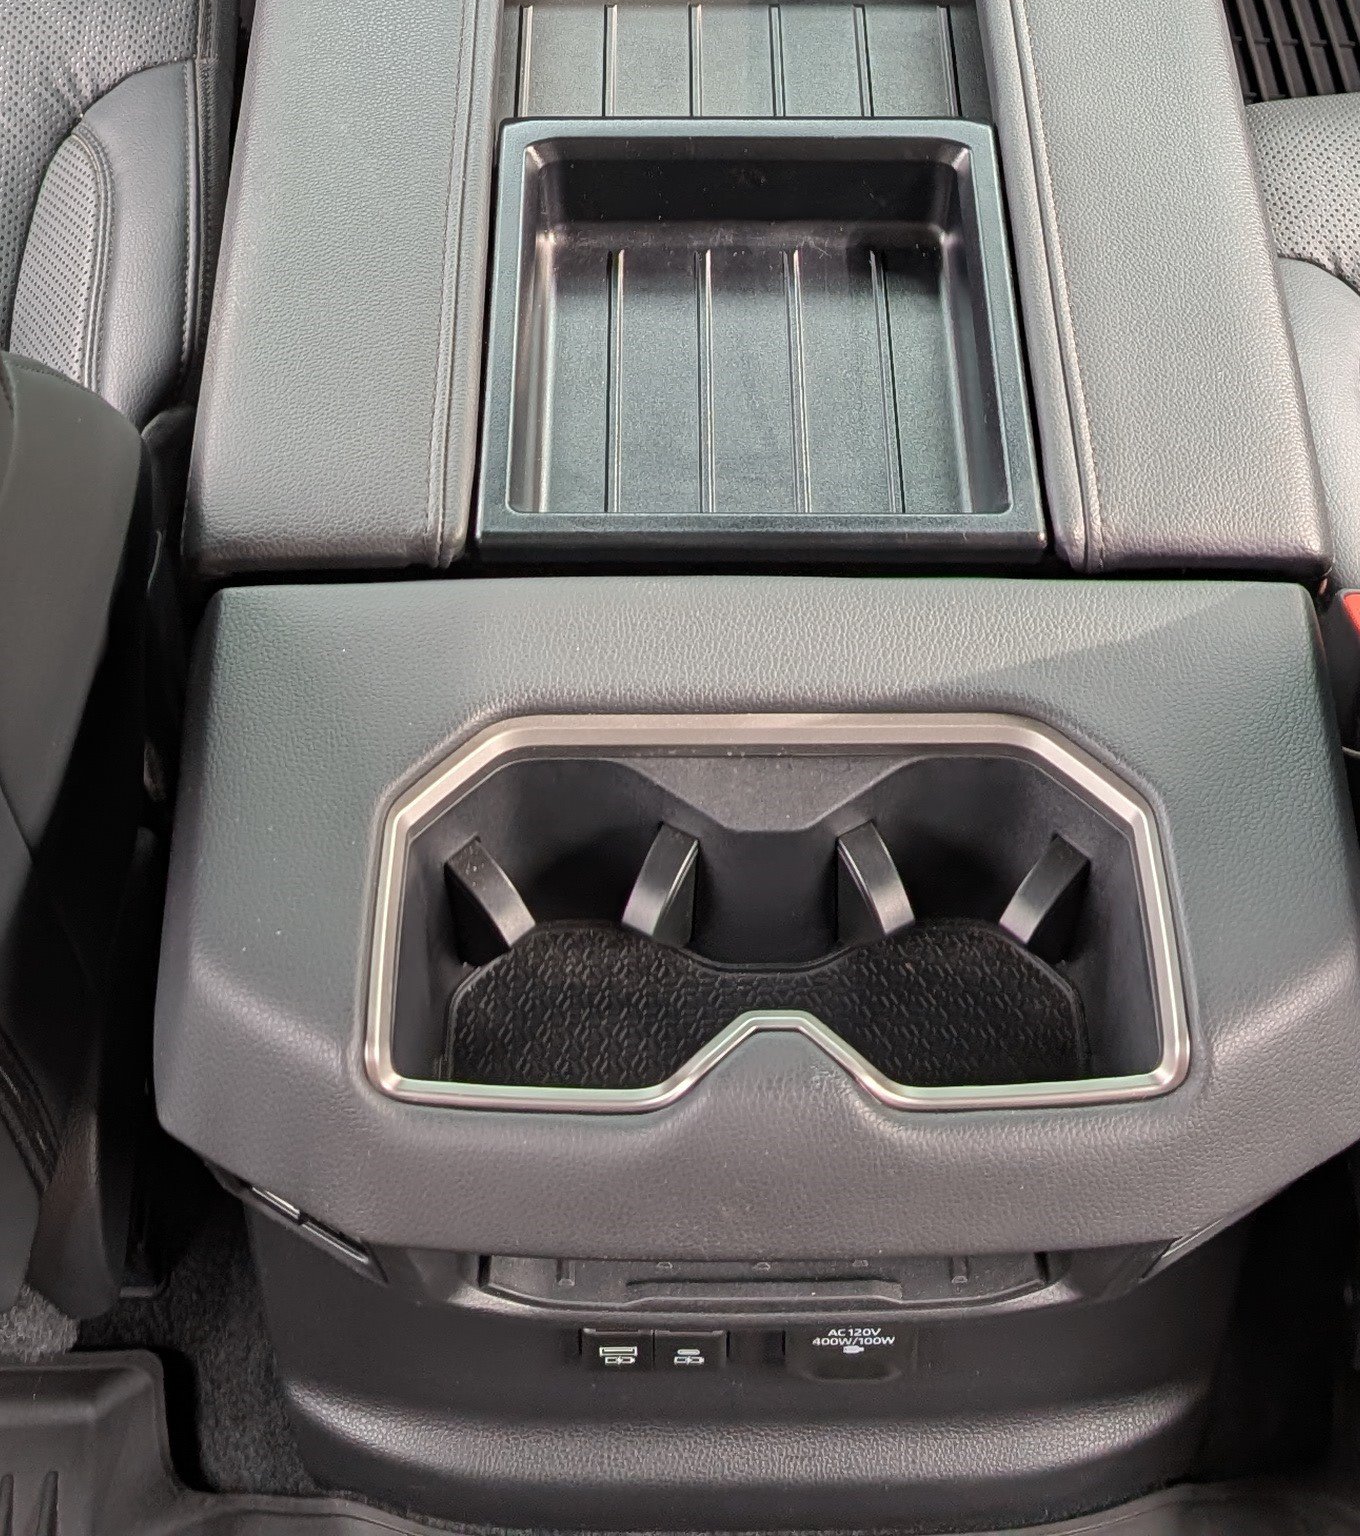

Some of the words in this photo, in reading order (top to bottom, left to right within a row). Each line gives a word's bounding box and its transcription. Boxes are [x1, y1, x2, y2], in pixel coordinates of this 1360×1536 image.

[828, 1328, 846, 1337] AC
[848, 1327, 882, 1337] 120V
[812, 1336, 896, 1346] 400W/100W
